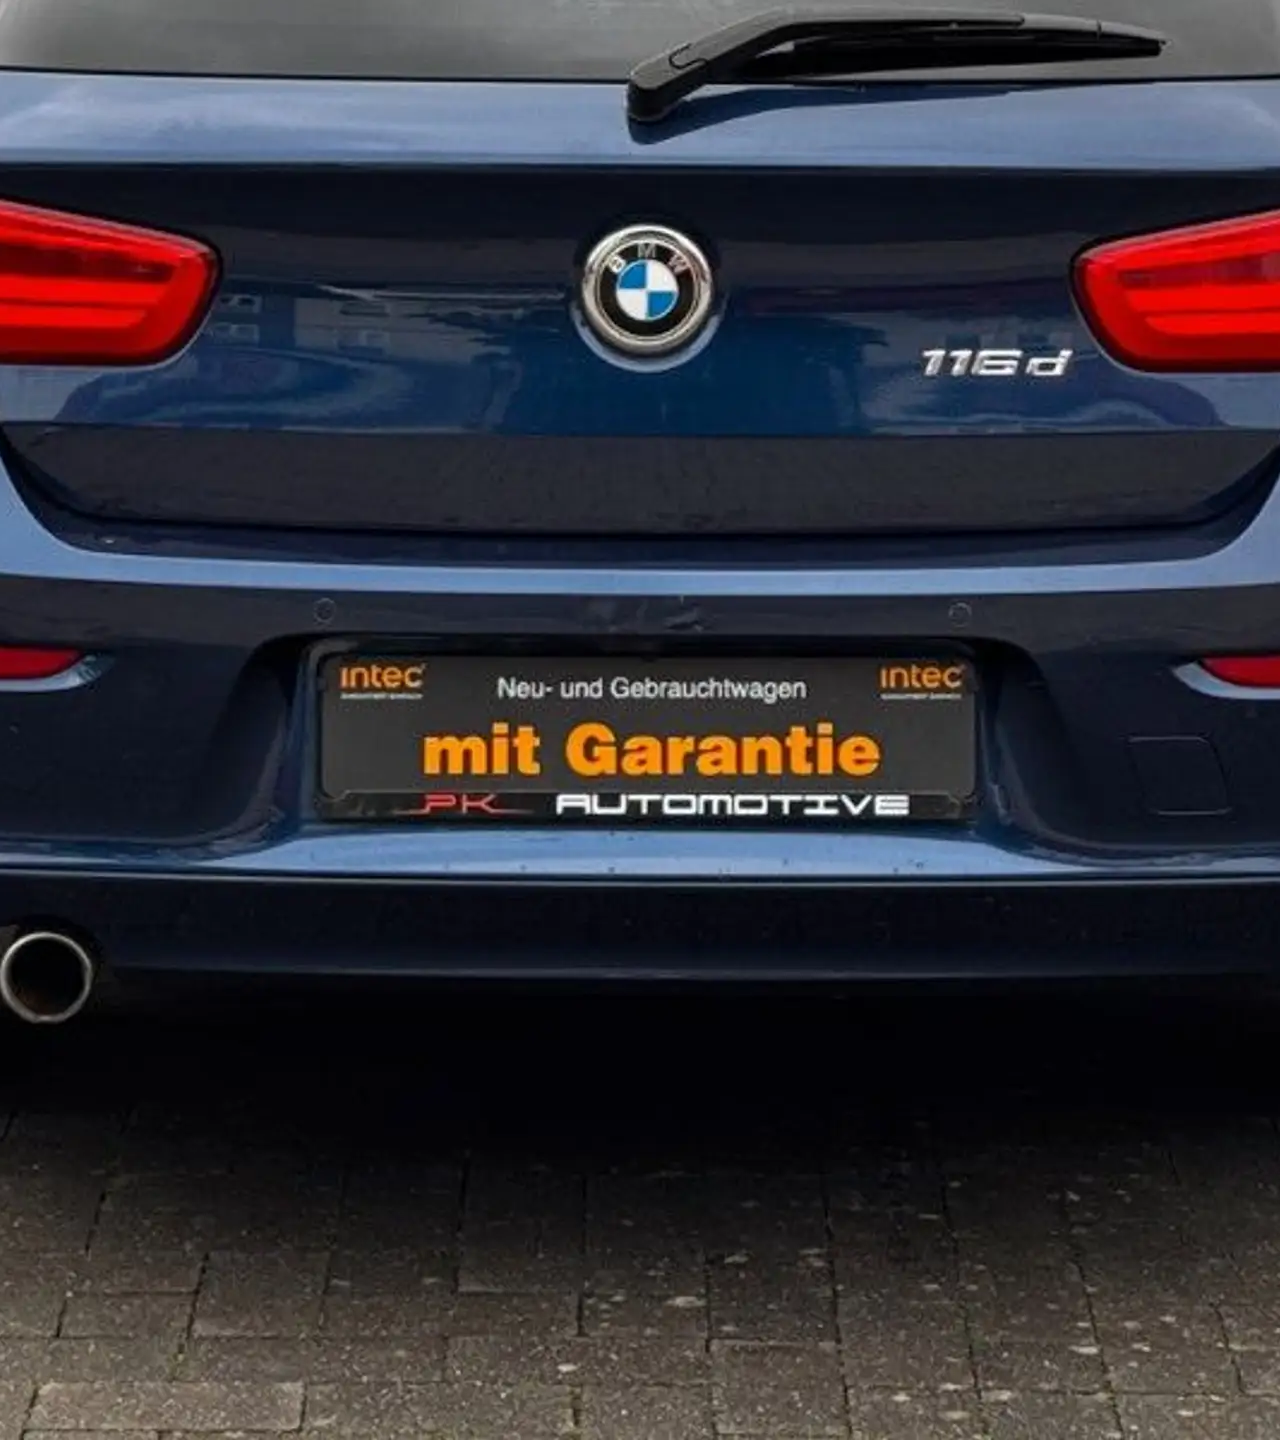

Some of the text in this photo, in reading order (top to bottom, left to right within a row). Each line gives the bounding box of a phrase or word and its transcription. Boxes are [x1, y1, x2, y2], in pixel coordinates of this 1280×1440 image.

[922, 349, 1073, 376] 116d
[339, 664, 424, 689] intec
[879, 664, 963, 689] intec
[498, 677, 806, 704] Neu- und Gebrauchtwagen
[424, 722, 880, 776] mit Garantie
[422, 793, 909, 816] PK AUTOMOTIVE
